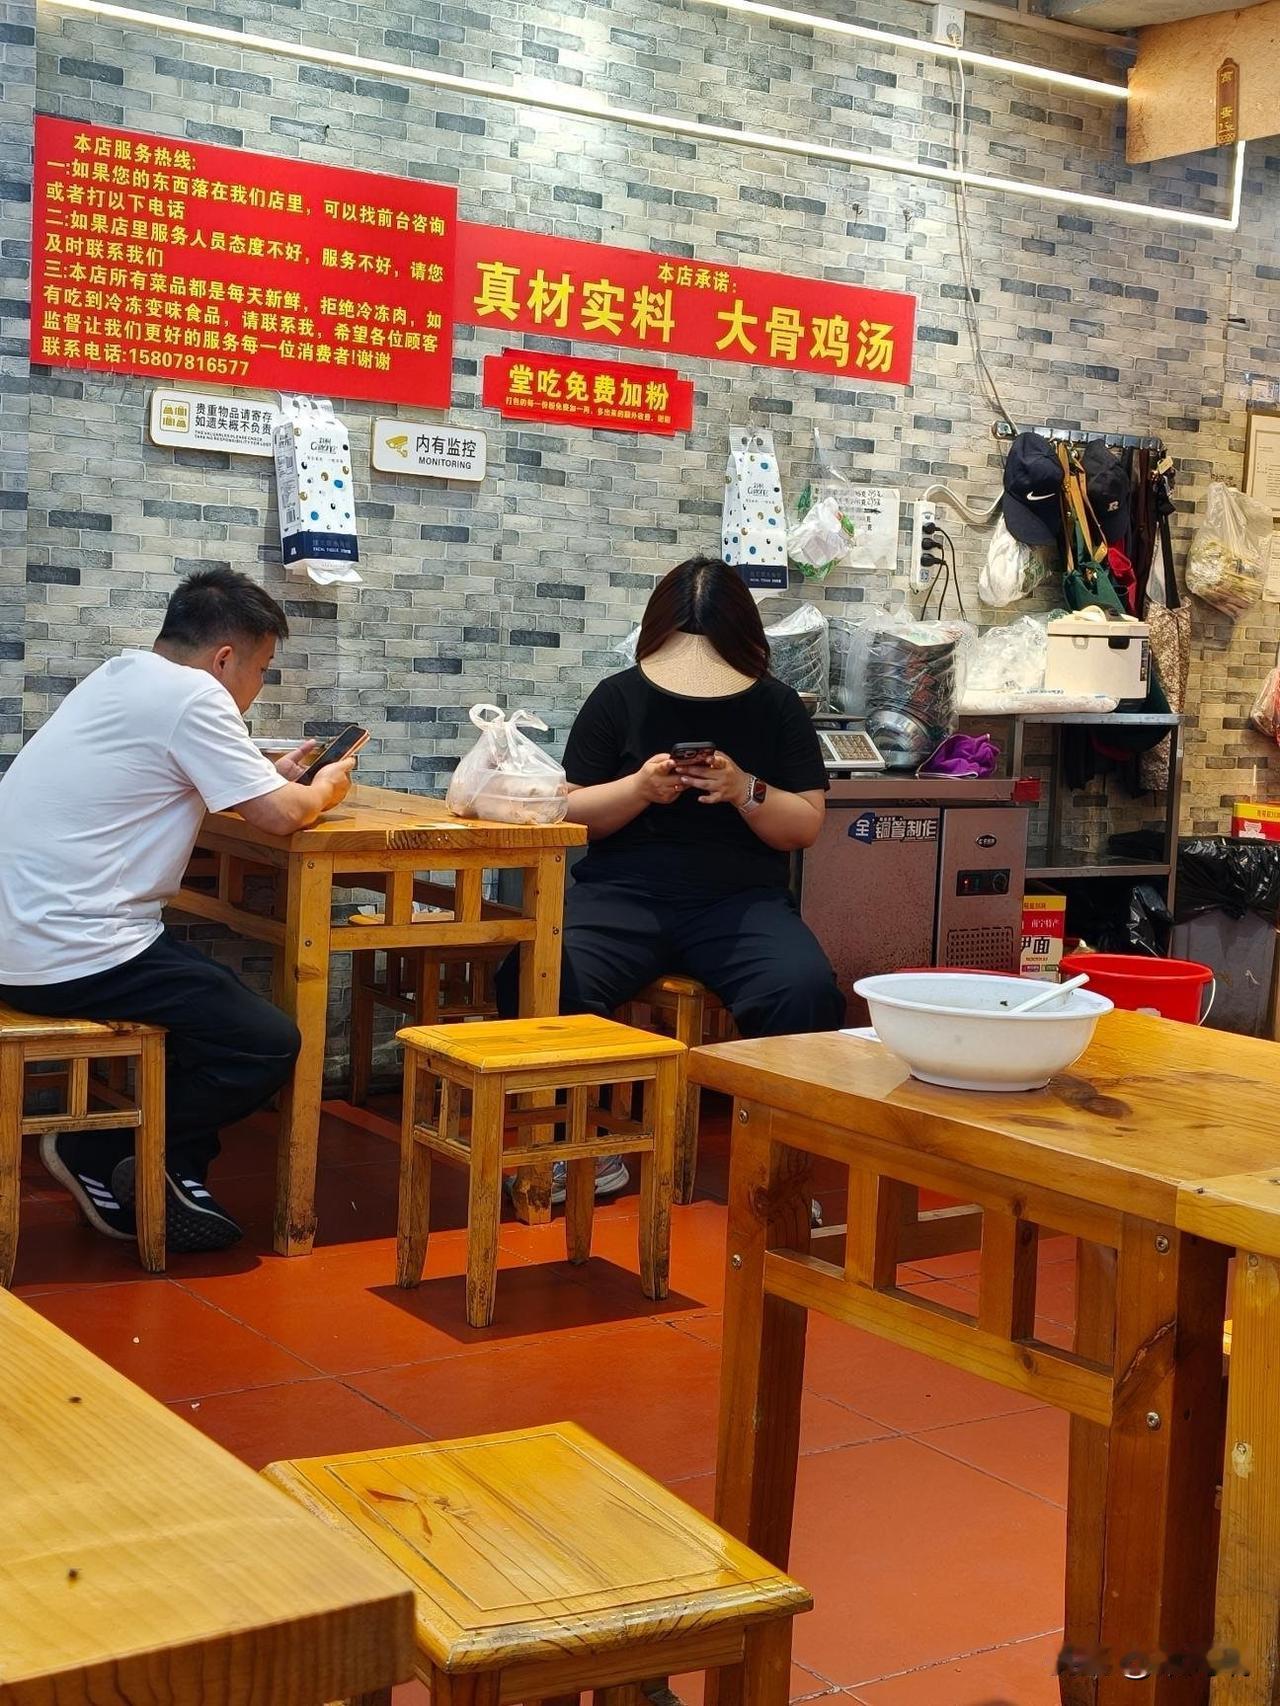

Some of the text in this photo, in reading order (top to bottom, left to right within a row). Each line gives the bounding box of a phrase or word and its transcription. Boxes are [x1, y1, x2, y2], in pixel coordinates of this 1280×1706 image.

[73, 133, 196, 170] 本店服务热线:
[46, 181, 185, 220] 或者打以下电话
[44, 232, 164, 268] 及时联系我们
[657, 262, 737, 293] 本店承诺:
[473, 261, 895, 373] 真材实料 大骨鸡汤
[41, 335, 250, 377] 联系电话:15807816577
[509, 363, 670, 412] 堂吃免费加粉
[194, 416, 271, 436] 如遗失概不负责
[195, 402, 273, 423] 贵重物品请寄存
[416, 433, 477, 458] 内有监控
[418, 456, 472, 470] MONITORING
